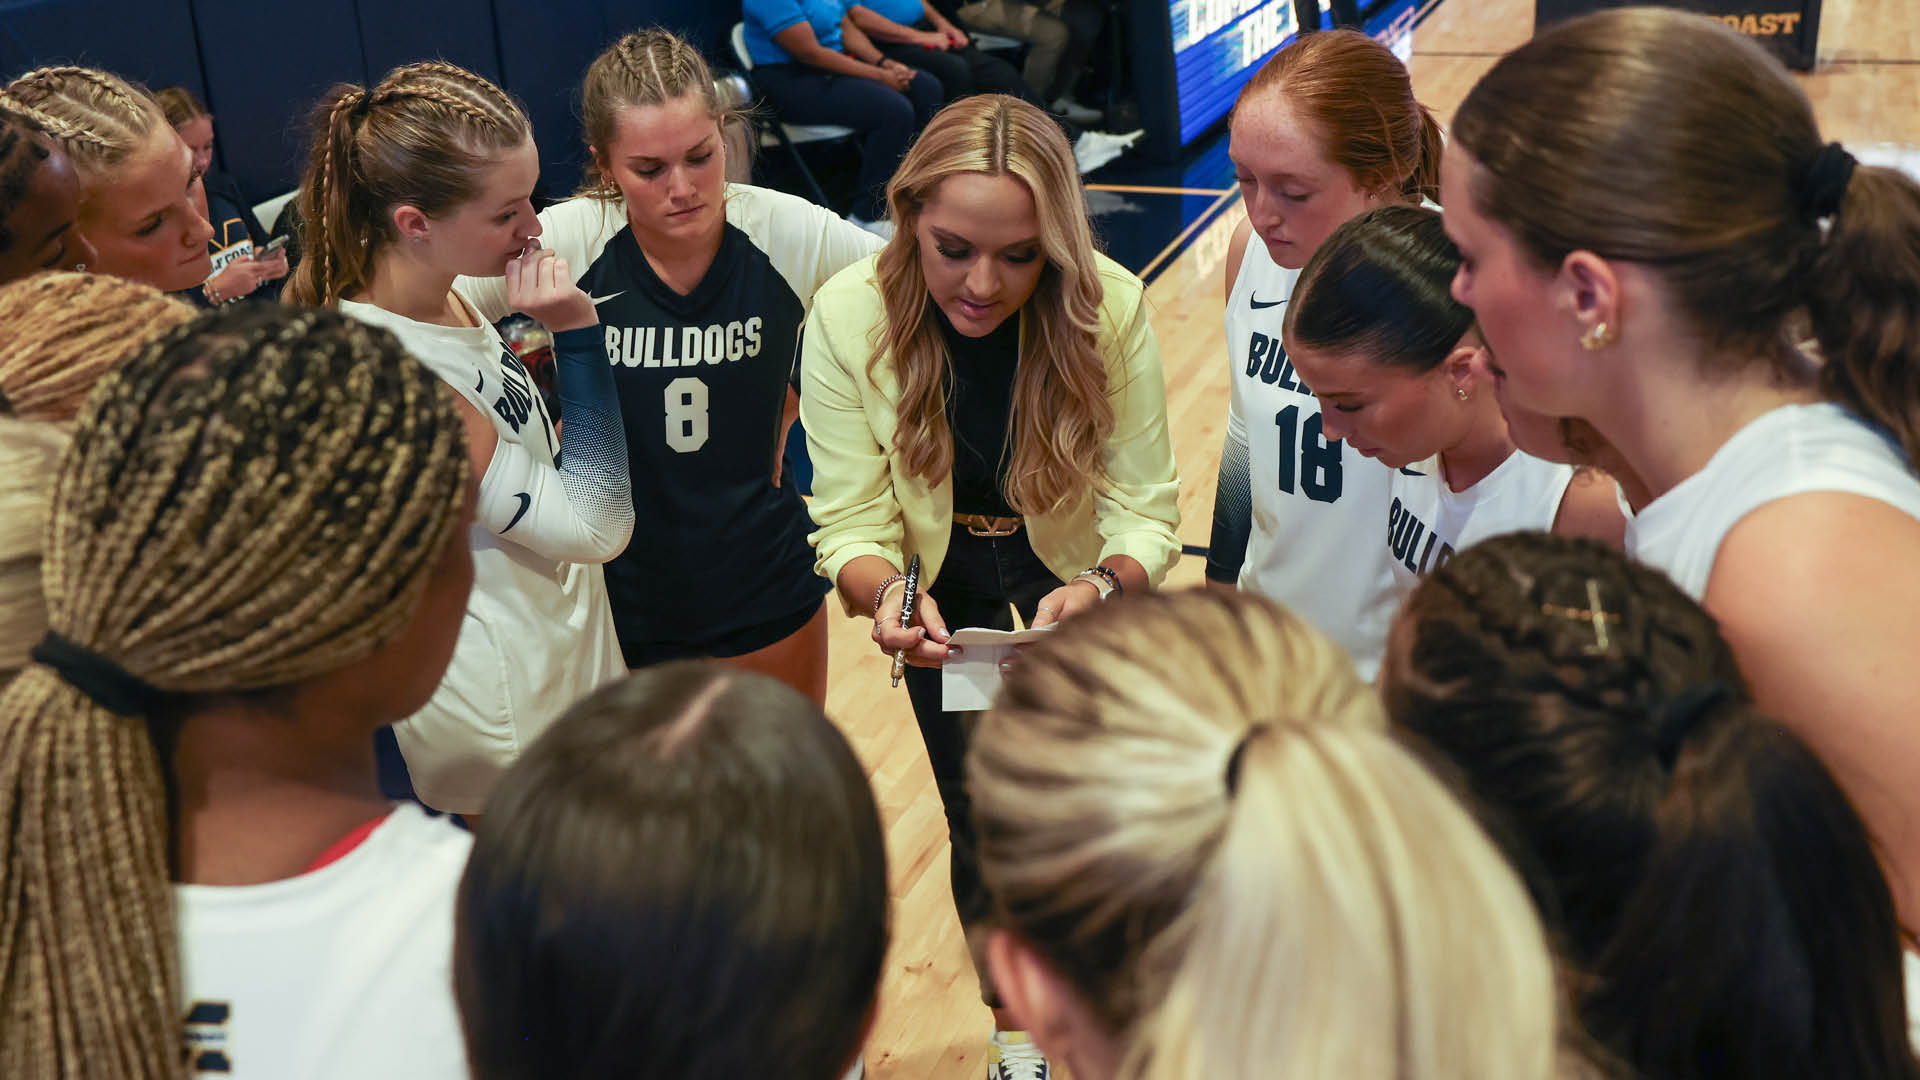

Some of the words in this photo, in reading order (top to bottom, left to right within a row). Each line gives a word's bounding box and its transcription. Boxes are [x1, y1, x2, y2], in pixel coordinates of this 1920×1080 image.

[1239, 0, 1287, 67] THE
[1705, 11, 1801, 36] OAST
[605, 316, 763, 368] BULLDOGS
[664, 377, 709, 453] 8
[1275, 404, 1343, 504] 18
